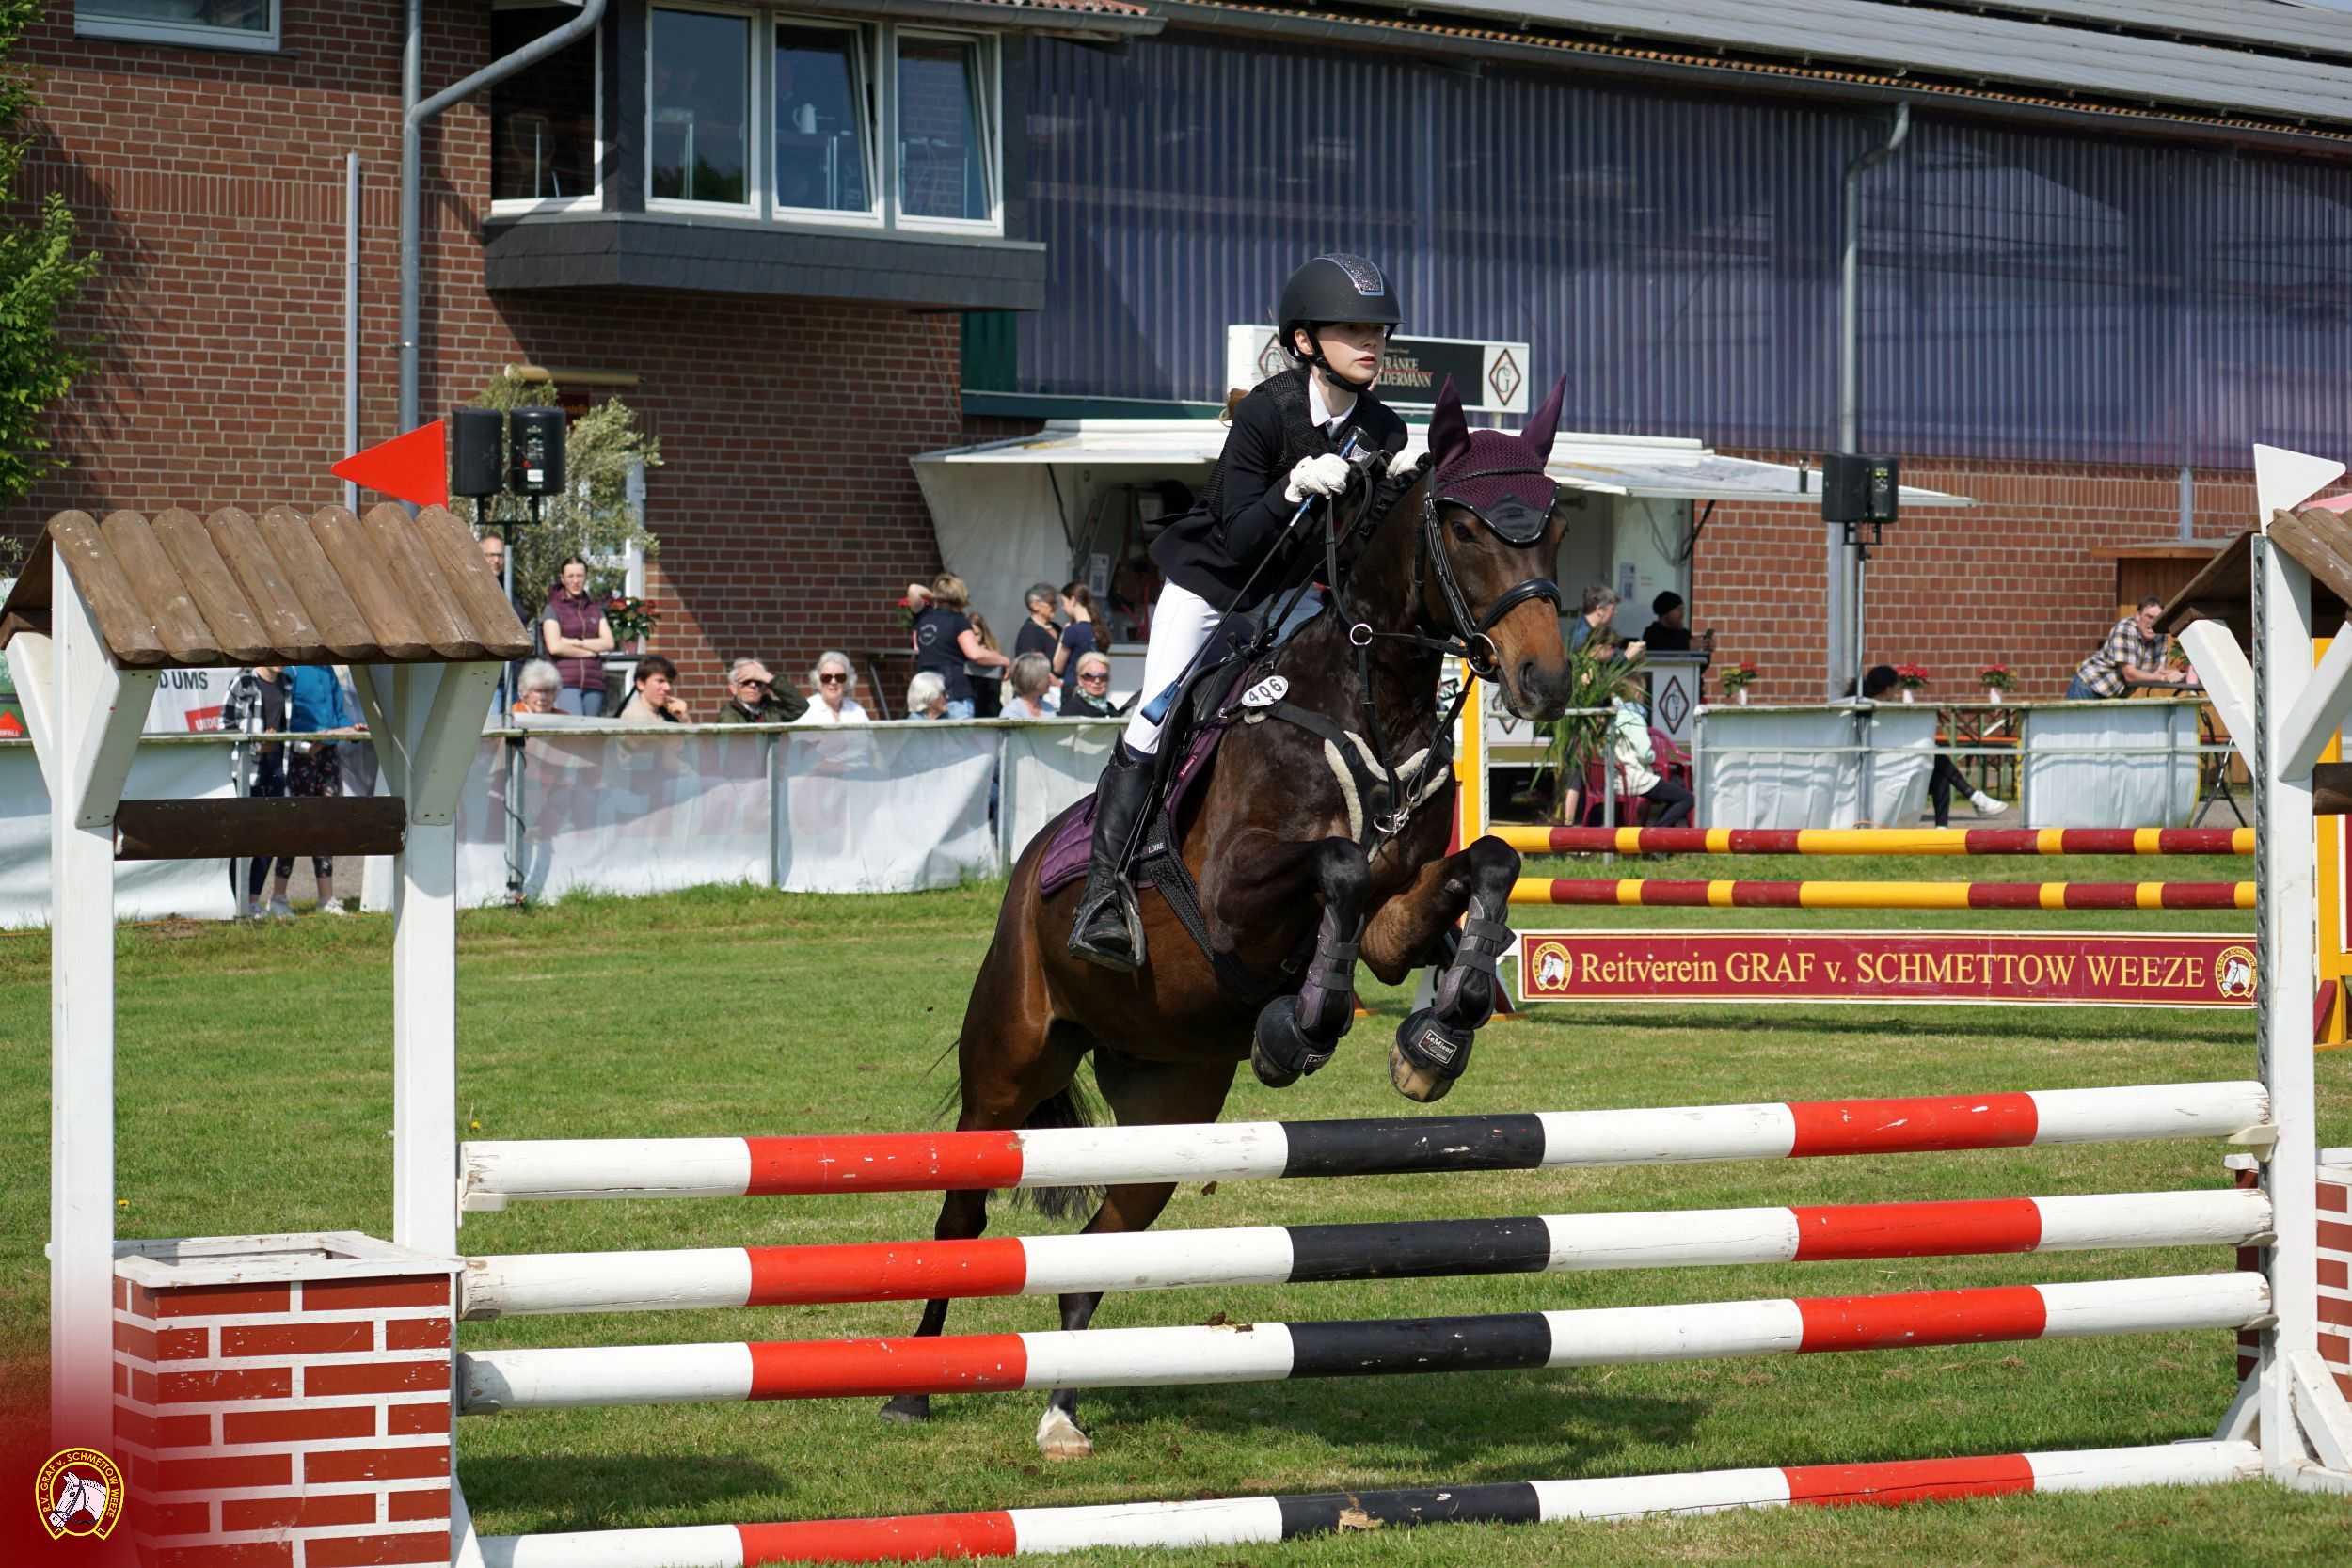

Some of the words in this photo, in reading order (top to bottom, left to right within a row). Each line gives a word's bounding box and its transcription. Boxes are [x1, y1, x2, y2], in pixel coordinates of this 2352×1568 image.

[171, 671, 209, 690] UMS
[1248, 678, 1283, 702] 406
[1580, 951, 1718, 984] Reitverein
[1725, 951, 1816, 984] GRAF
[1824, 962, 1847, 984] v.
[1856, 952, 2076, 987] SCHMETTOW
[2085, 954, 2206, 988] WEEZE
